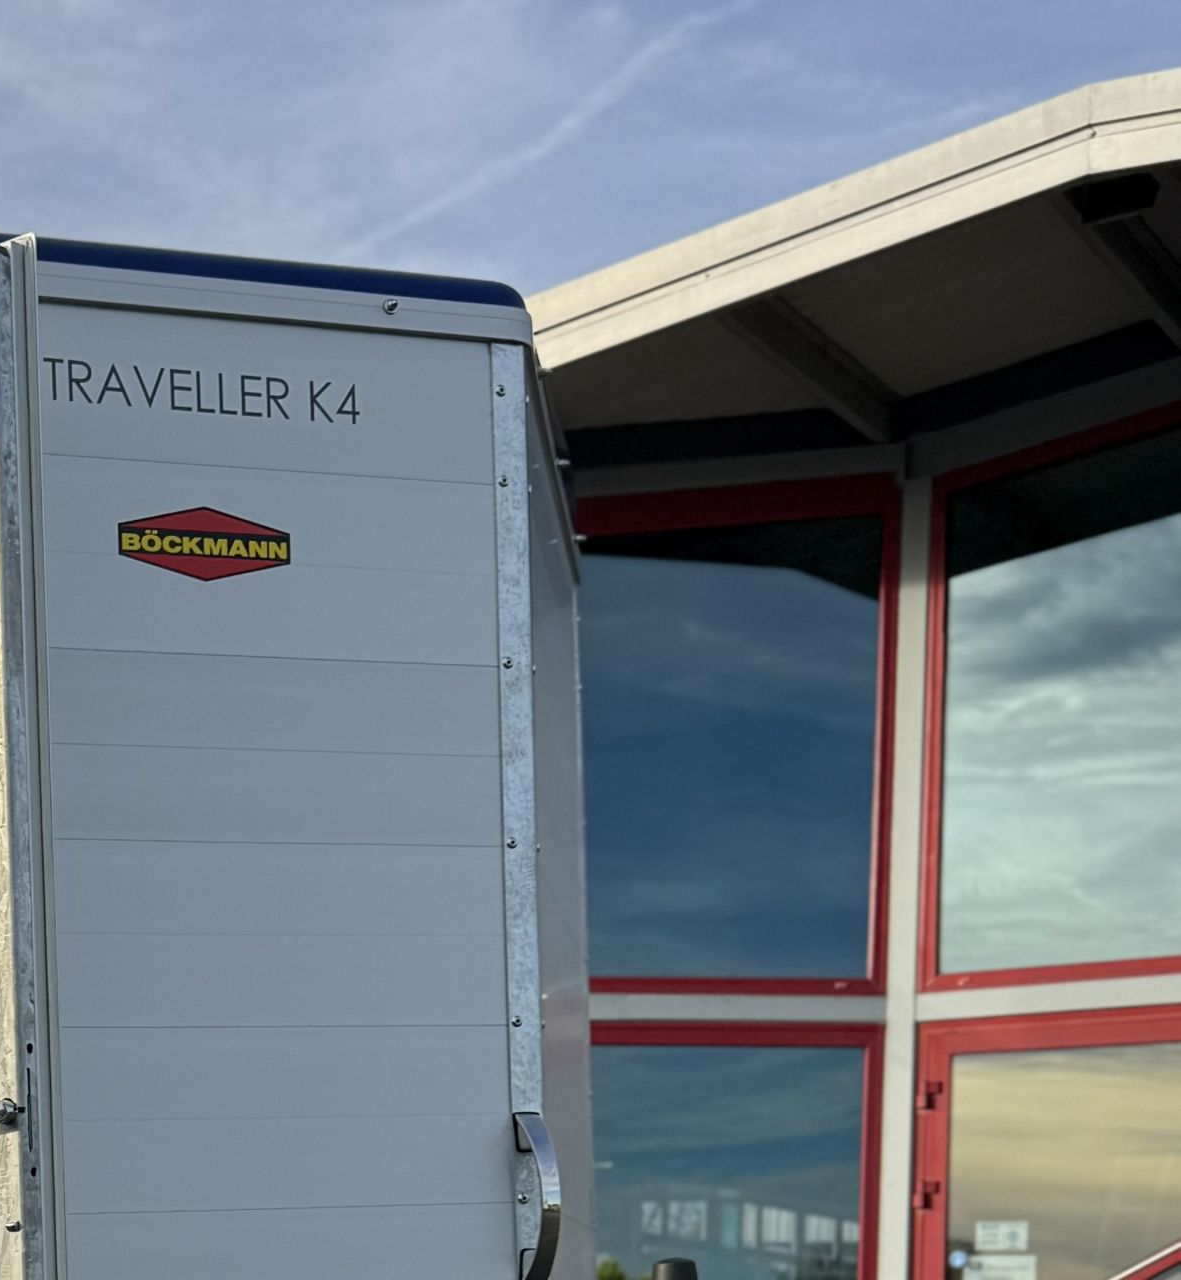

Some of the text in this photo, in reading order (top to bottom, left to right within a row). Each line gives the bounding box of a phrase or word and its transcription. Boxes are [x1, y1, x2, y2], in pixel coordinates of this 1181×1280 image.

[43, 357, 361, 426] TRAVELLER K4
[120, 529, 288, 560] BÖCKMANN
